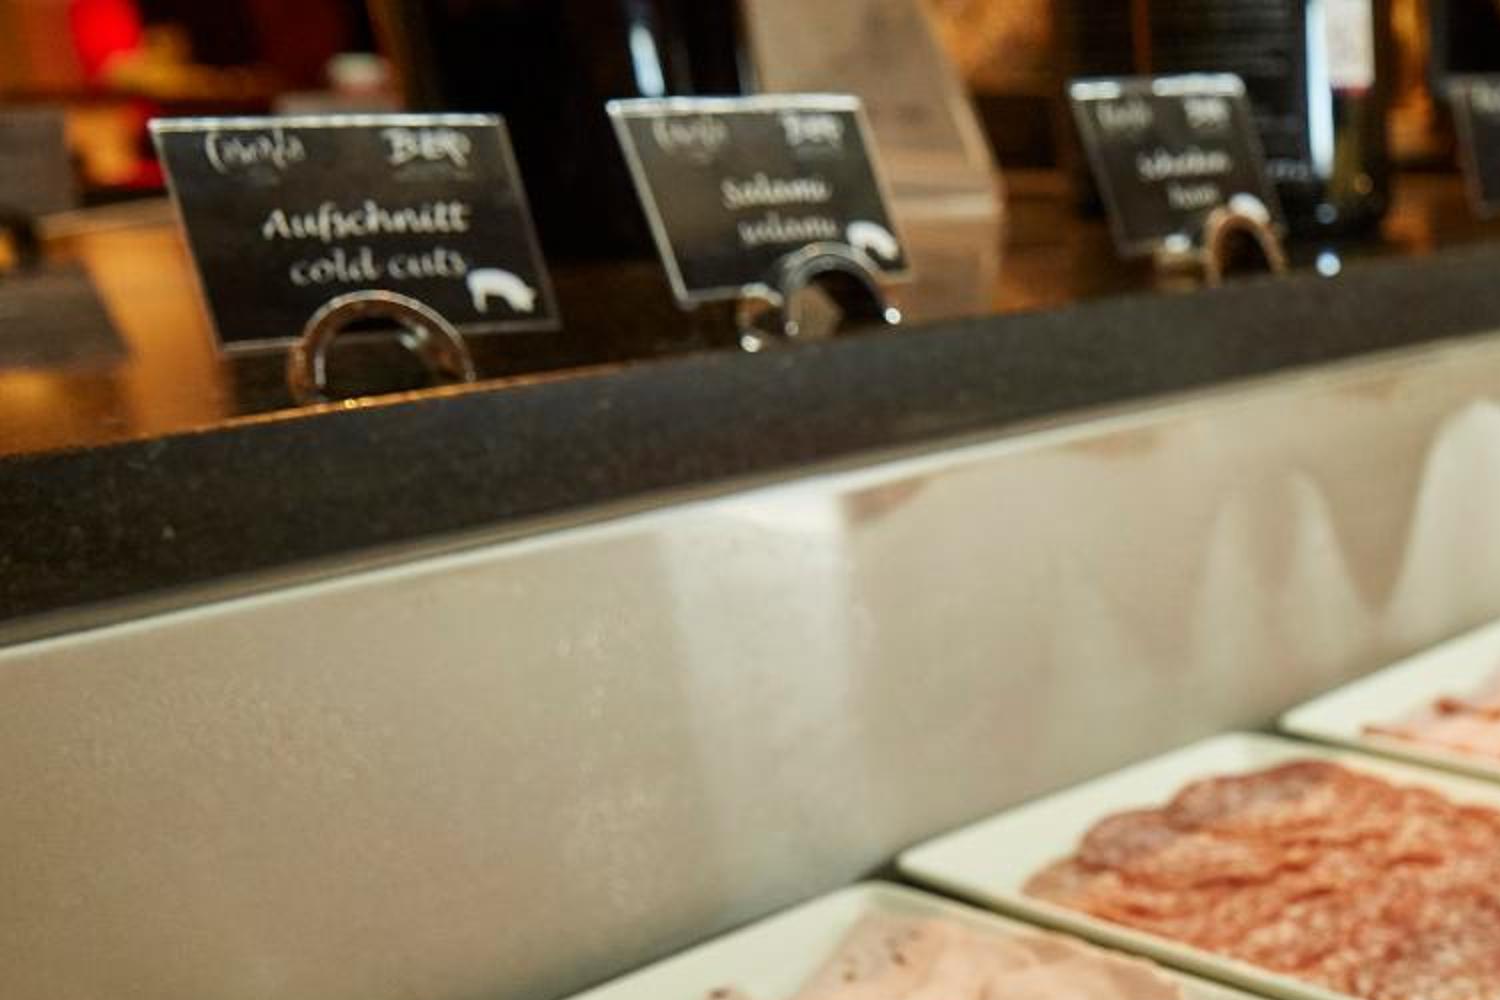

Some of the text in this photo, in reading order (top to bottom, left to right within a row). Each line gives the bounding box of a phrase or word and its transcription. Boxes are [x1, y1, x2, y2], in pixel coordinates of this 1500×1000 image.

[262, 201, 472, 243] Aufschnitt
[289, 246, 467, 286] cold cuts
